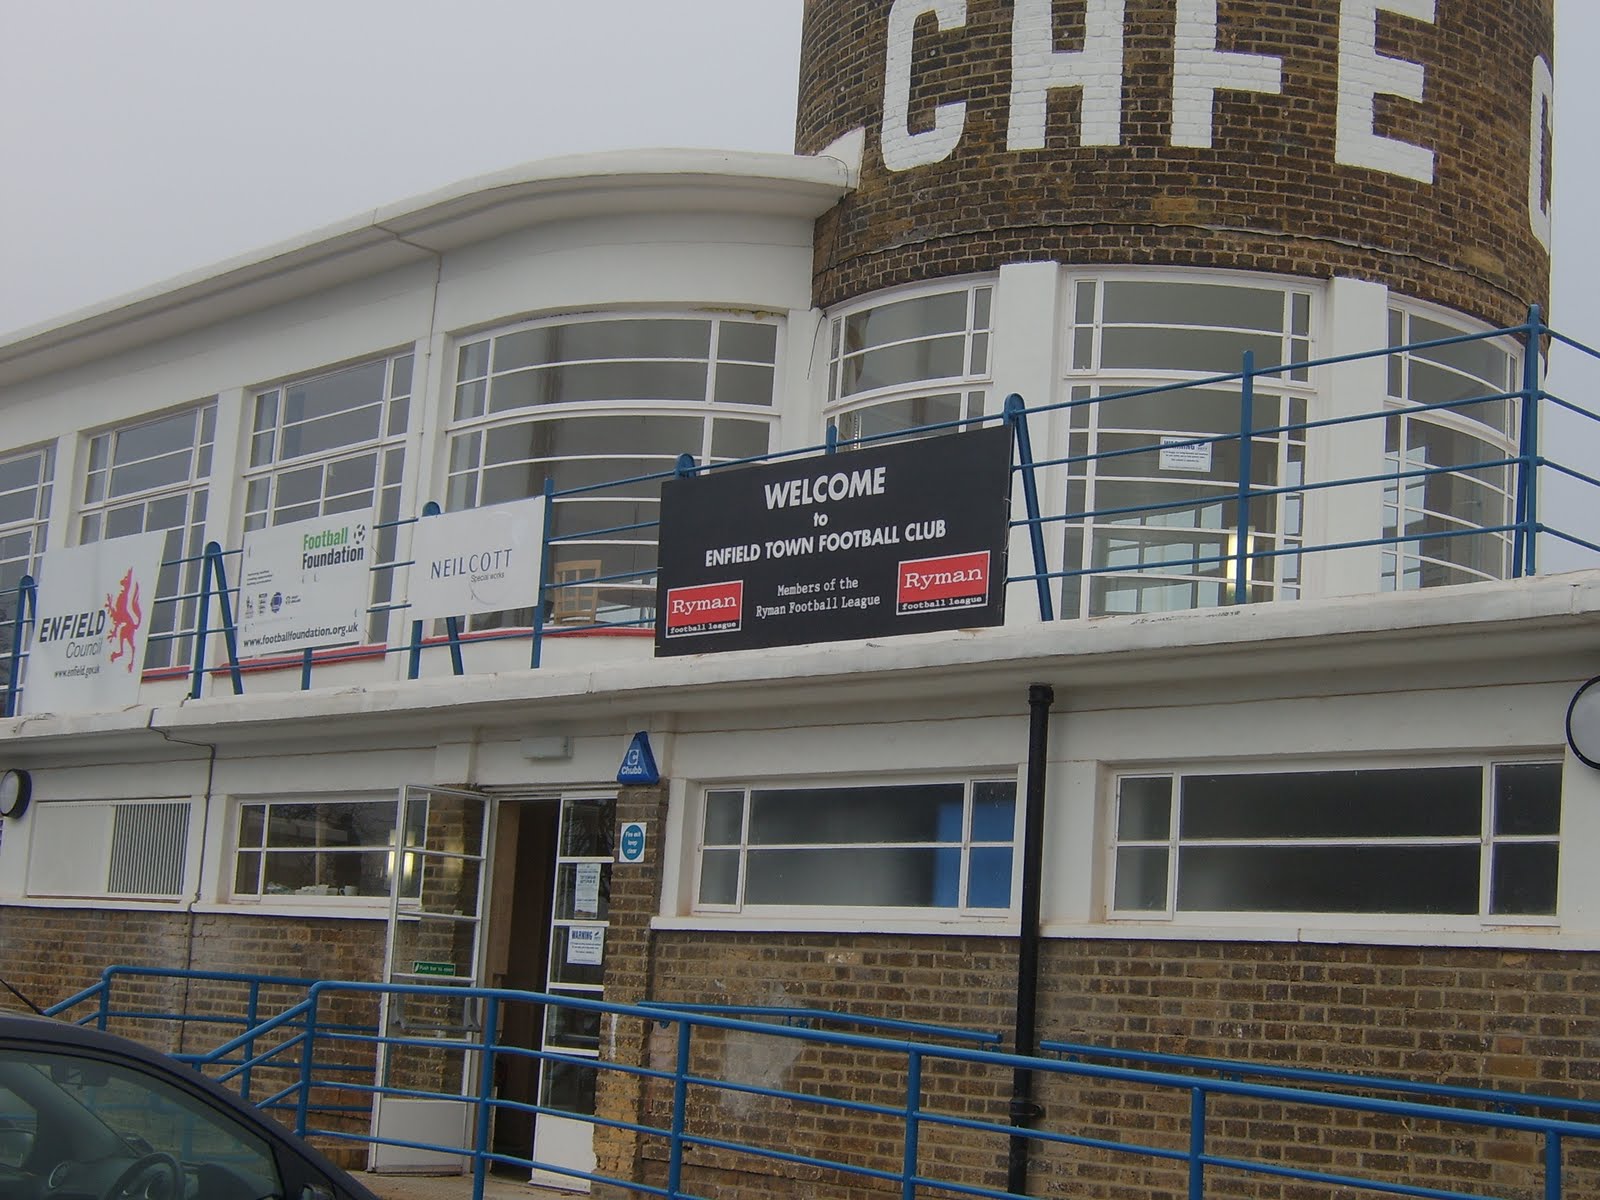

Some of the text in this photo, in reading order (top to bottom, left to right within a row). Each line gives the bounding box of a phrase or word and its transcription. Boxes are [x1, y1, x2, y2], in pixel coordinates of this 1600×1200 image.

[880, 0, 1436, 185] CAFE
[764, 466, 887, 510] WELCOME
[813, 512, 829, 528] to
[303, 527, 349, 550] Football
[705, 519, 947, 567] ENFIELD TOWN FOOTBALL CLUB
[302, 546, 364, 570] Foundation
[430, 548, 513, 580] NEILCOTT
[470, 573, 489, 583] Special
[777, 577, 859, 597] Members of the
[903, 567, 983, 590] Ryman
[671, 595, 737, 616] Ryman
[755, 595, 881, 619] Ryman Football League
[901, 596, 982, 611] football league
[38, 609, 106, 643] ENFIELD
[243, 622, 359, 647] www.footballfoundation.org.uk
[669, 621, 737, 634] football league
[65, 641, 103, 659] Council
[53, 664, 101, 679] www.enfield.gov.uk
[621, 766, 643, 775] Chubb
